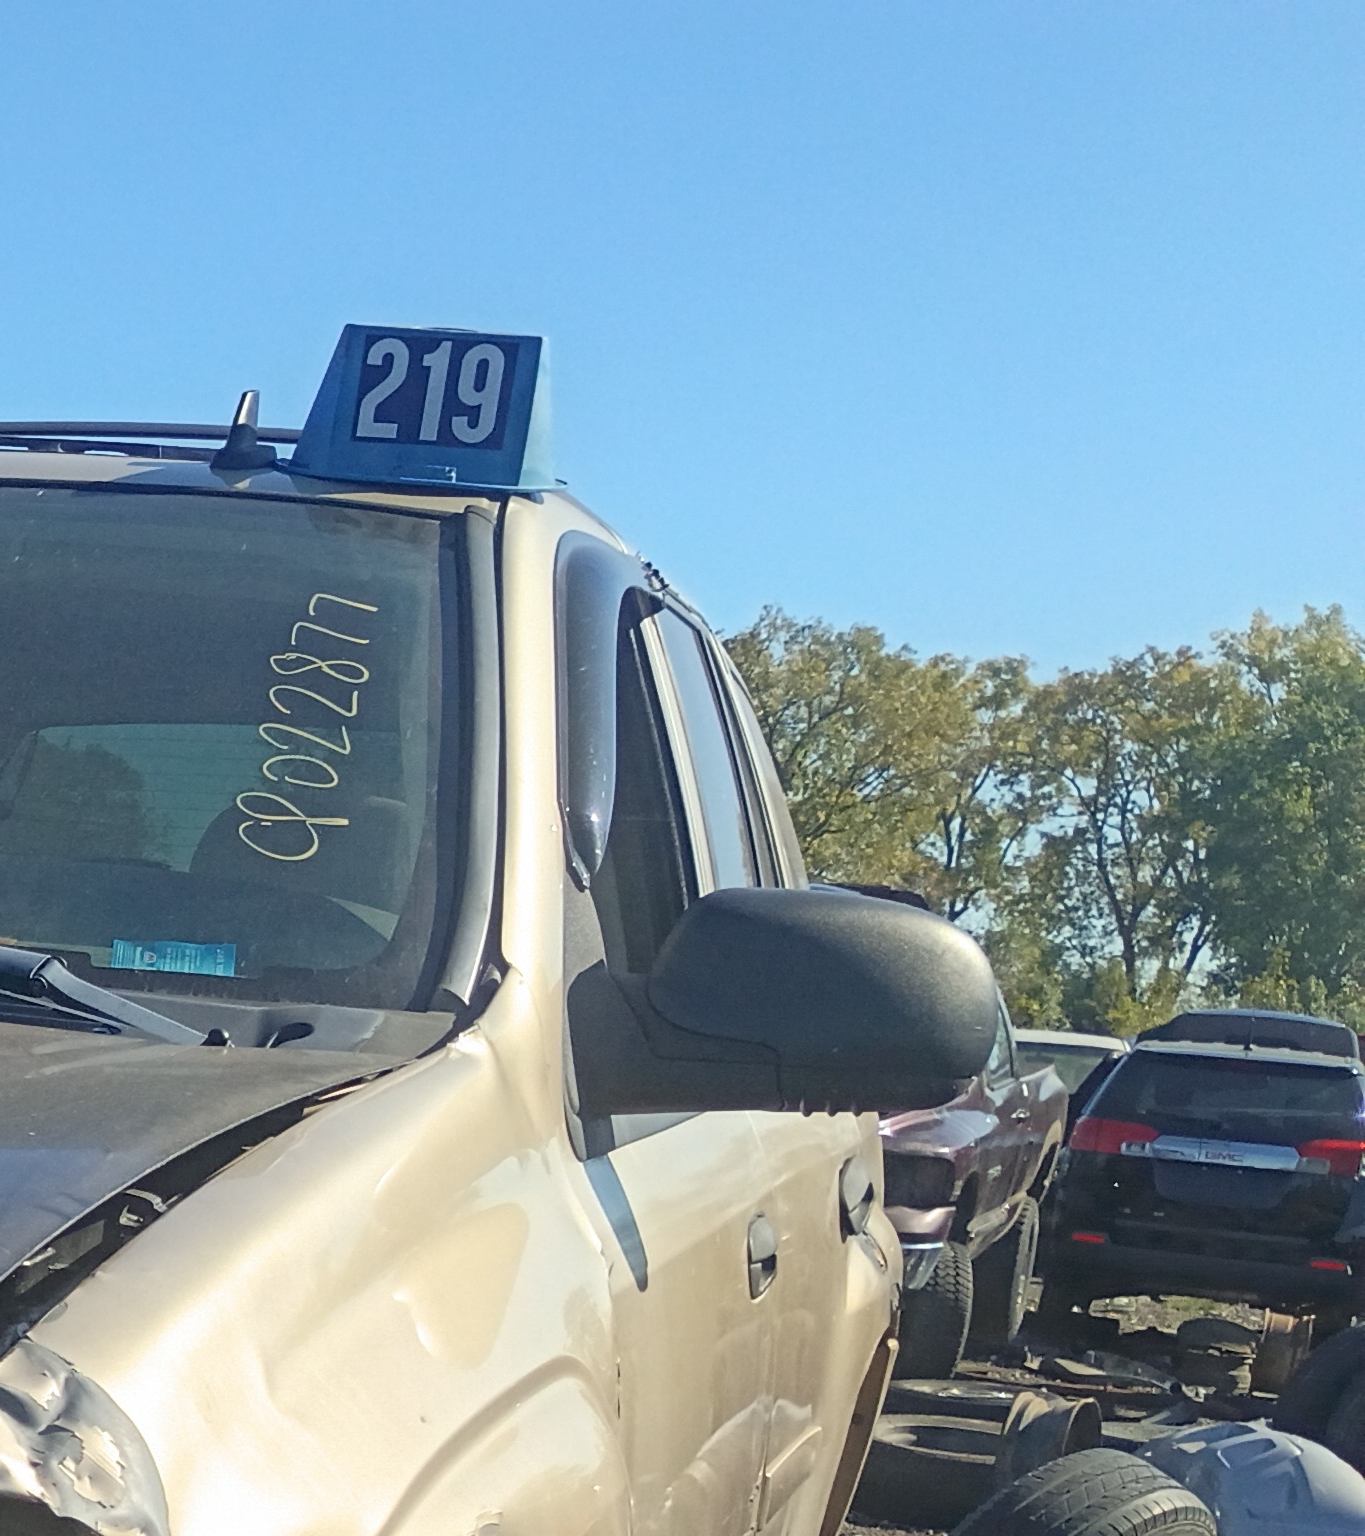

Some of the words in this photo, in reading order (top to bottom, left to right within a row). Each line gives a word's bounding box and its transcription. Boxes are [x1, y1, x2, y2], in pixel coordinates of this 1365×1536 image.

[356, 338, 506, 444] 219
[235, 593, 379, 861] CP022877
[1206, 1151, 1244, 1164] GMC
